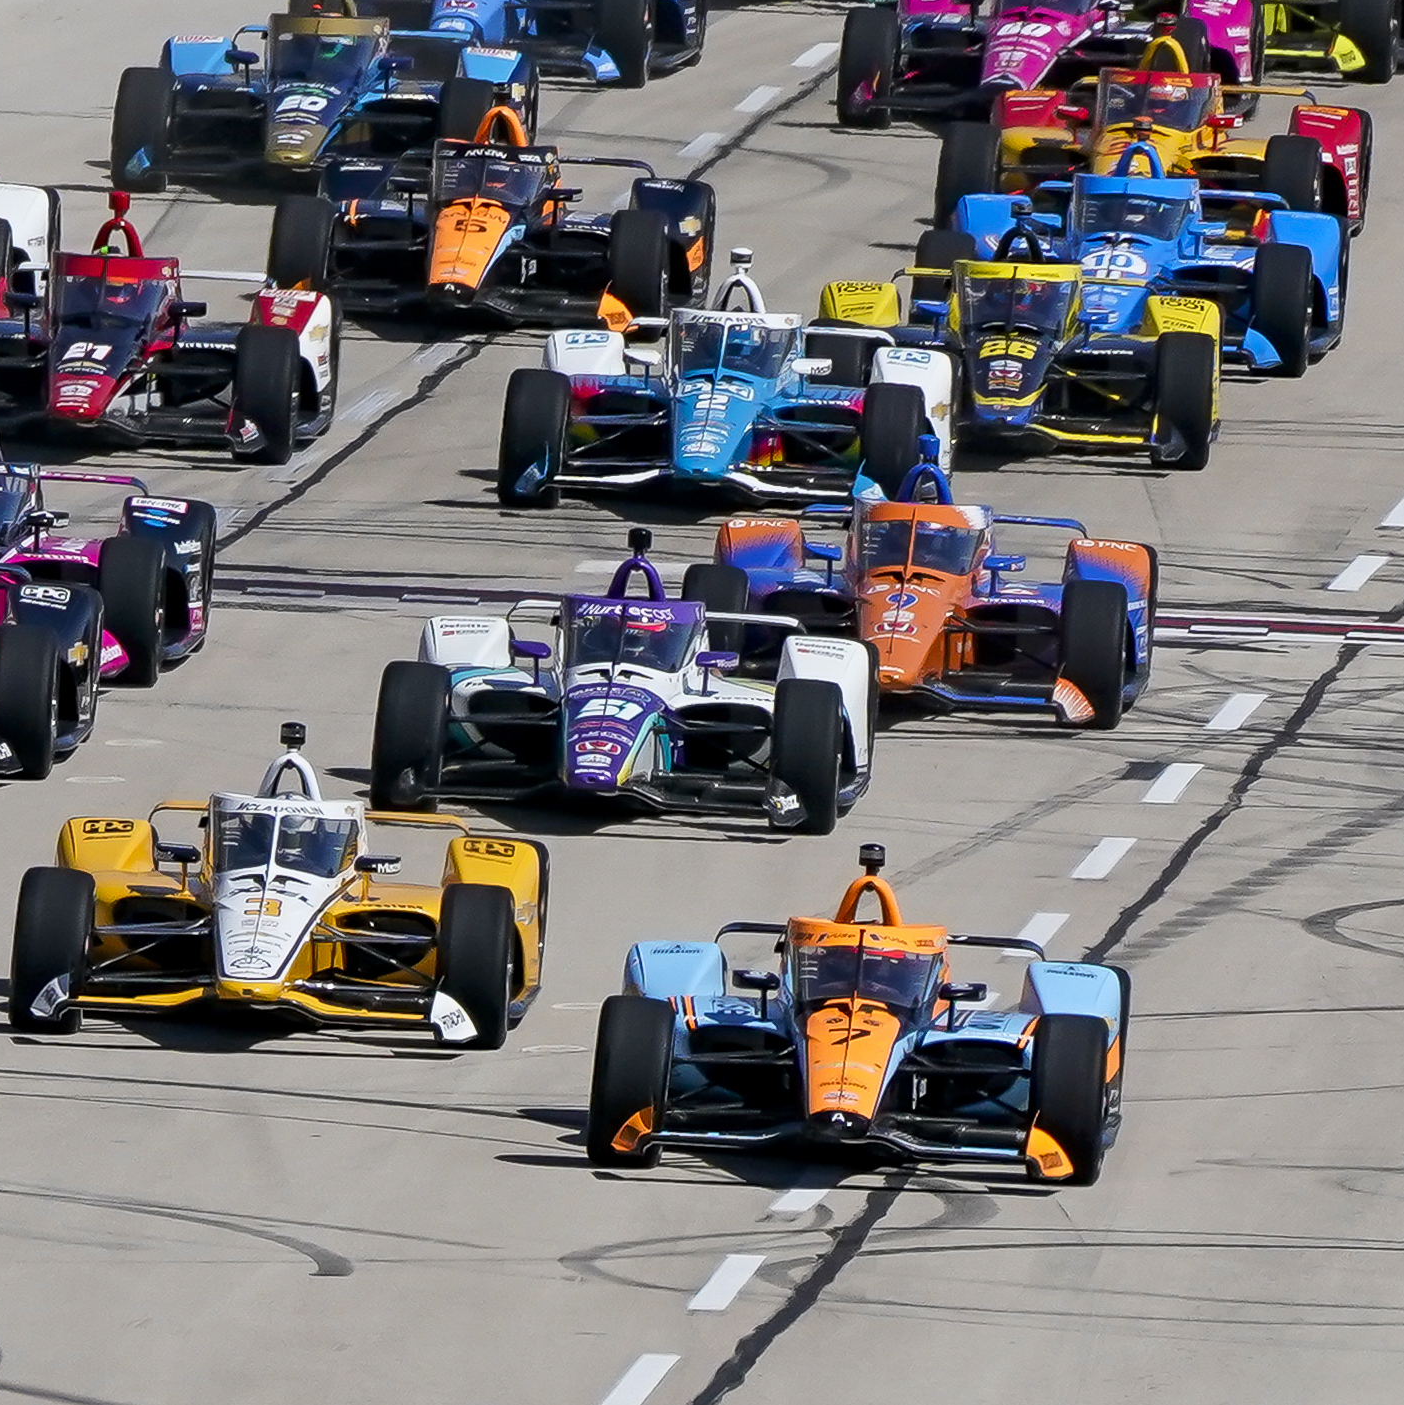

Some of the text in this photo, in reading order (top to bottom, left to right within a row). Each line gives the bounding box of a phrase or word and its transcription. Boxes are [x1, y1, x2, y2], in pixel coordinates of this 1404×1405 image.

[979, 338, 1038, 360] 26
[749, 520, 789, 528] PNC
[1098, 541, 1138, 553] PNC
[24, 588, 69, 602] PPG
[574, 697, 644, 721] 51
[235, 799, 325, 816] MCLAUGHLIN
[84, 821, 133, 833] PPG
[245, 897, 283, 916] 3
[827, 1029, 872, 1047] 7
